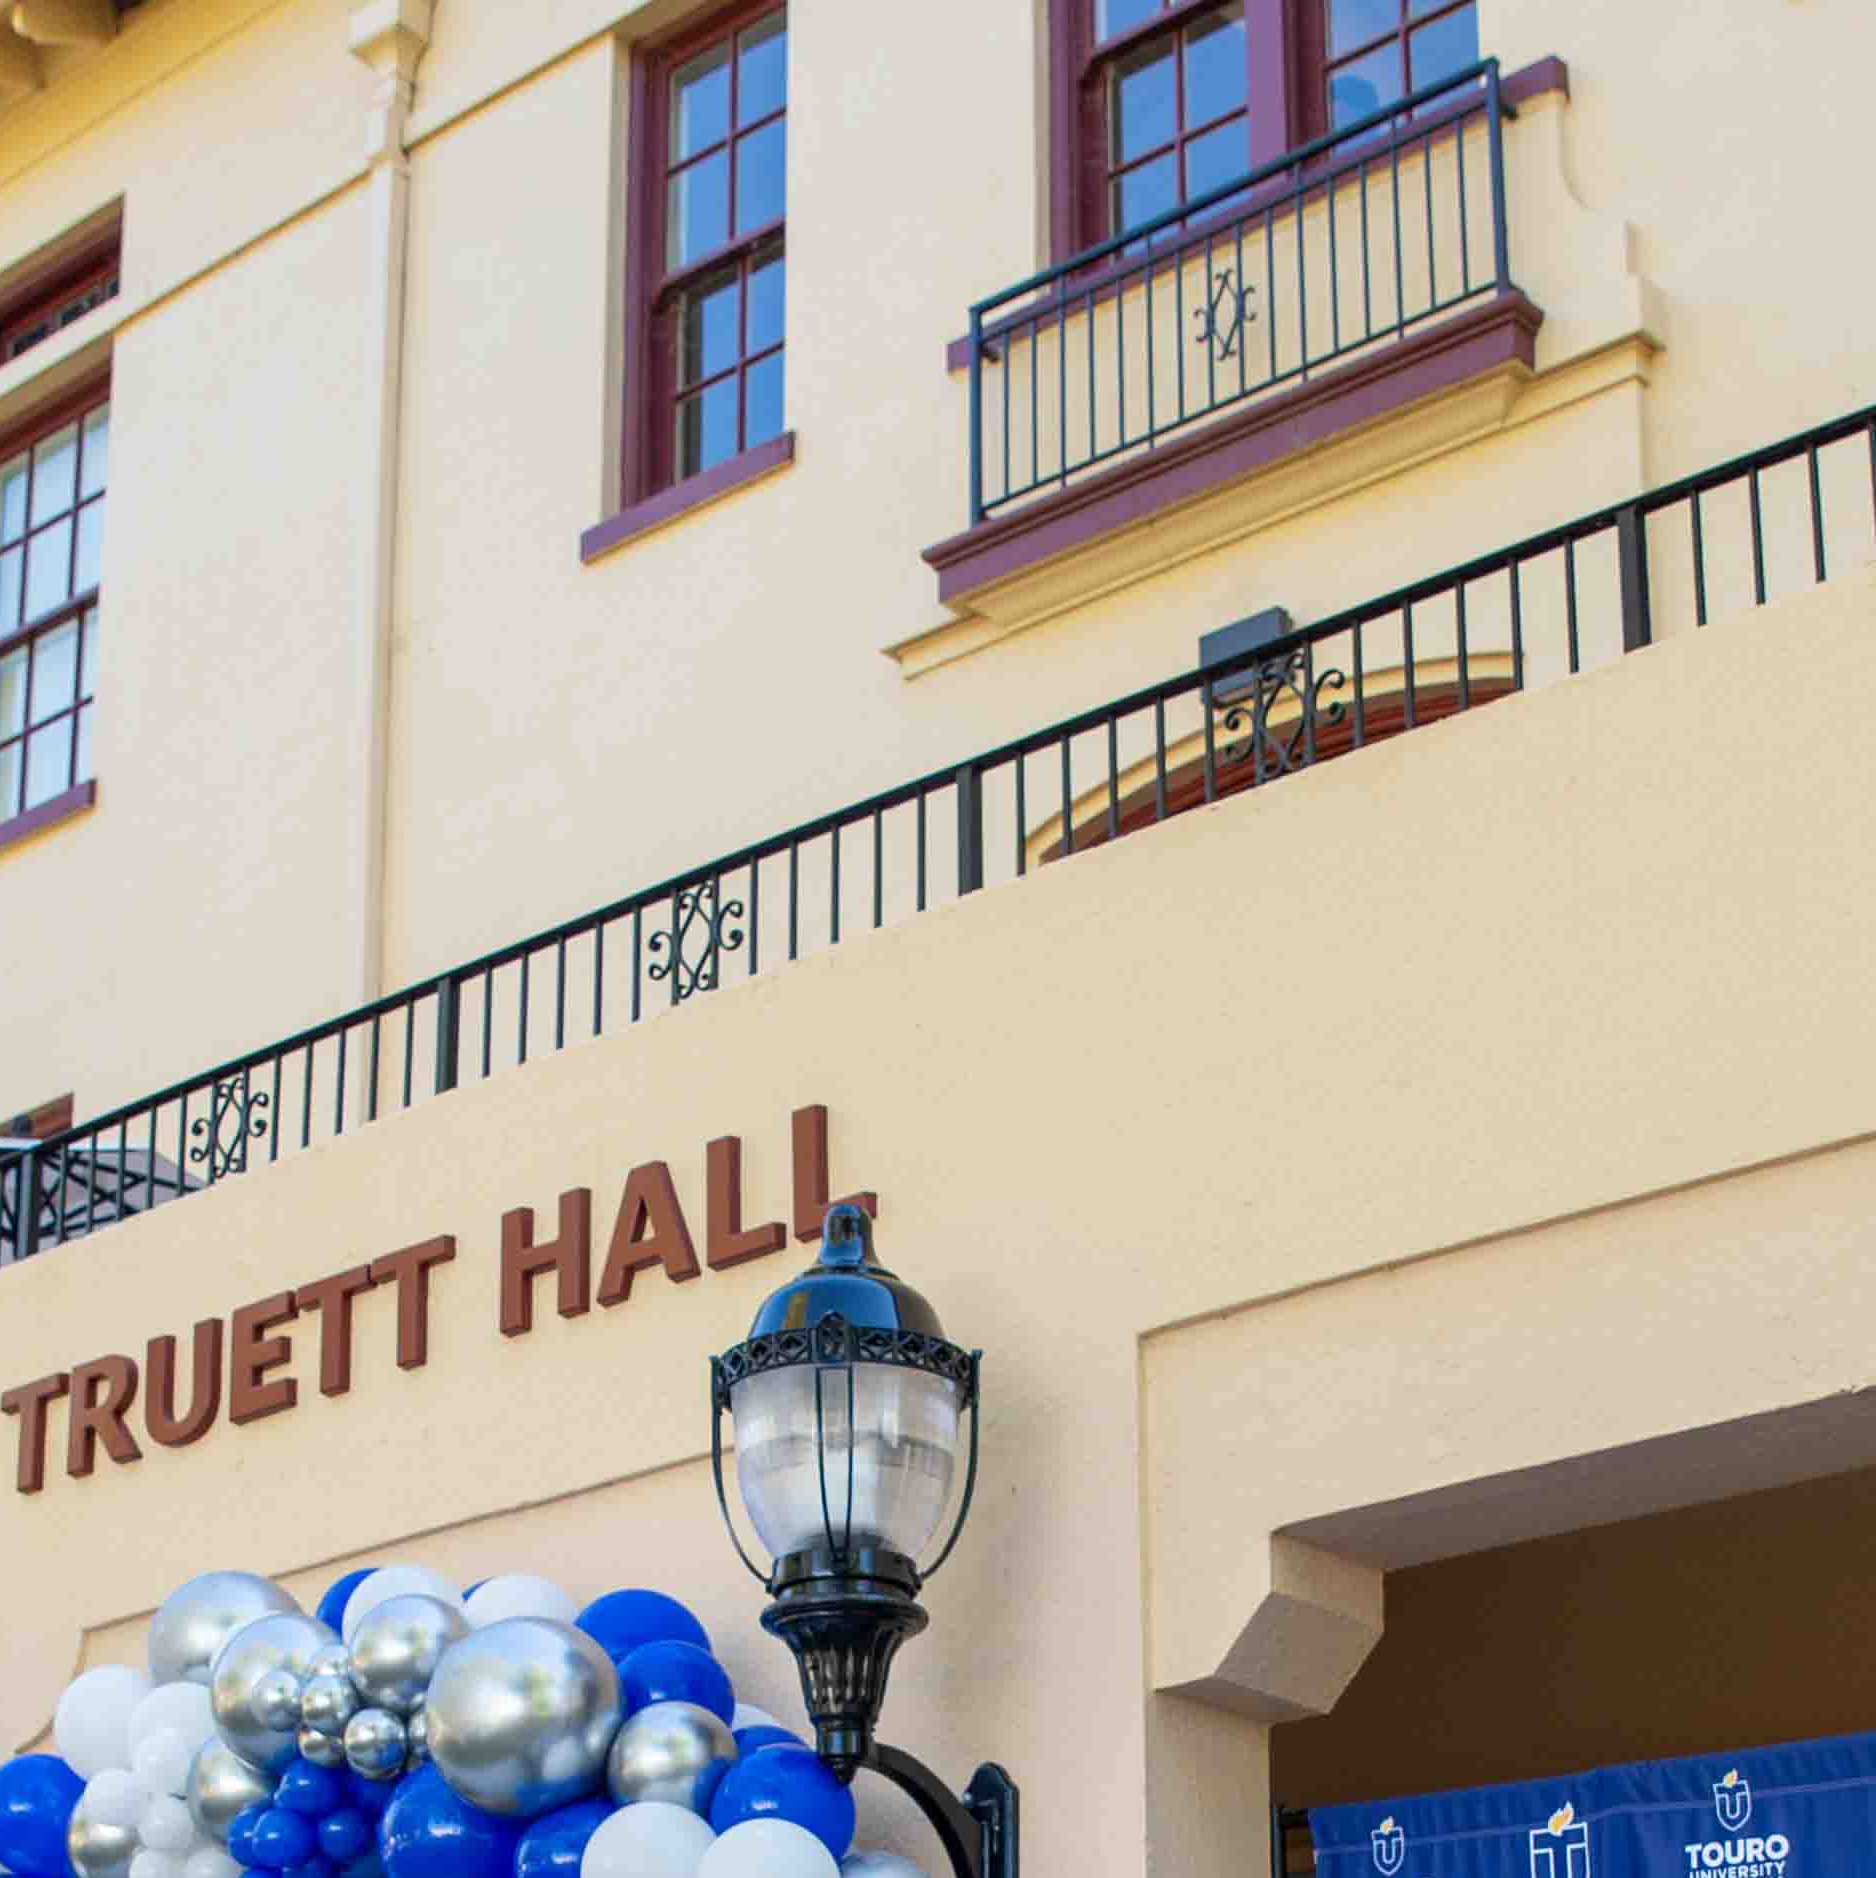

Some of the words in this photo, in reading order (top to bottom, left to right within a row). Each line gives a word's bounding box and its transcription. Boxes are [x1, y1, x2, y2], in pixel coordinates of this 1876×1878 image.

[1, 1235, 456, 1494] TRUETT
[500, 1104, 878, 1338] HALL
[1685, 1835, 1789, 1868] TOURO
